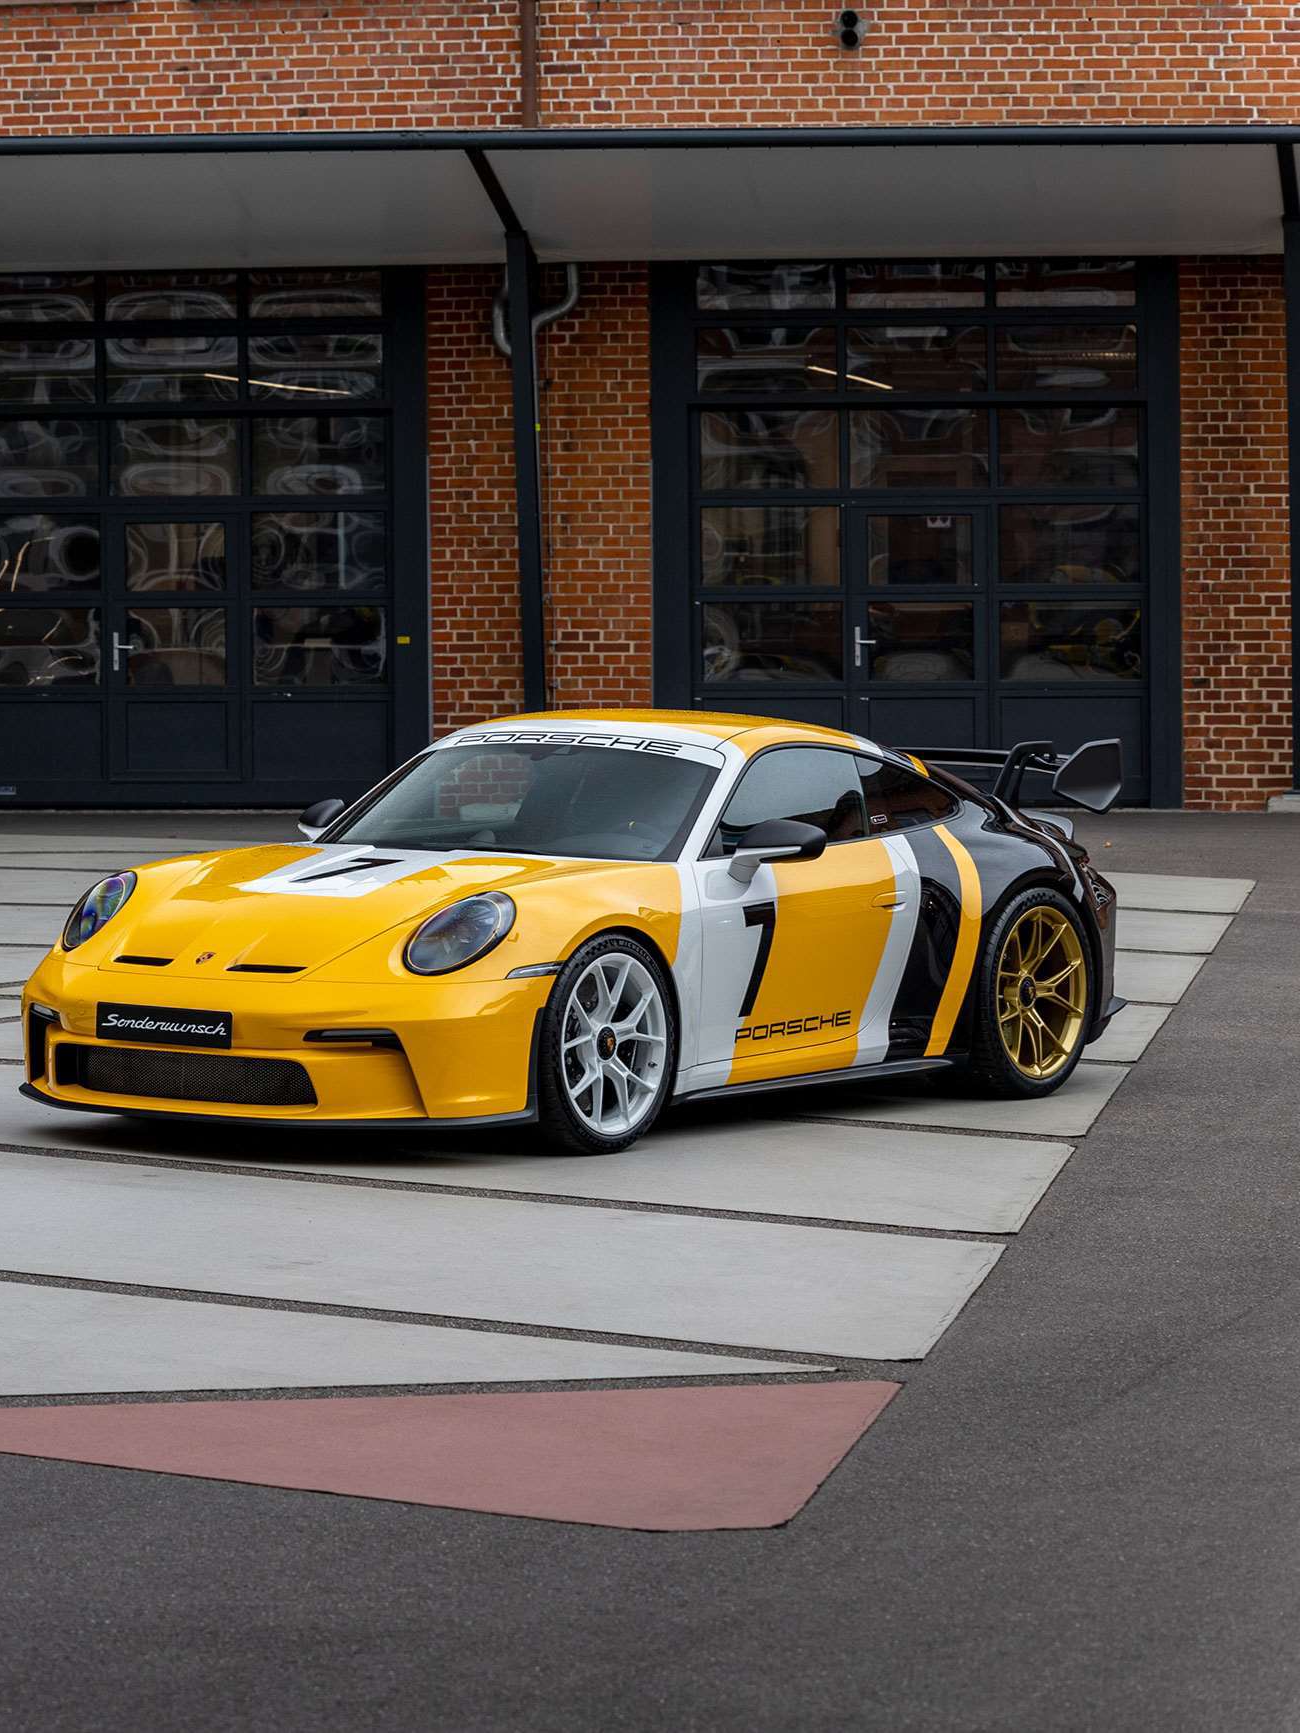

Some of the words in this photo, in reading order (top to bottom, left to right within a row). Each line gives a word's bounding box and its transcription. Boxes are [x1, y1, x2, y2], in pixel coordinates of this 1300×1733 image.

[457, 733, 683, 755] PORSCHE
[289, 858, 404, 883] 7
[738, 901, 776, 1018] 7
[102, 1014, 227, 1036] Sonderwunsch
[735, 1010, 852, 1043] PORSCHE
